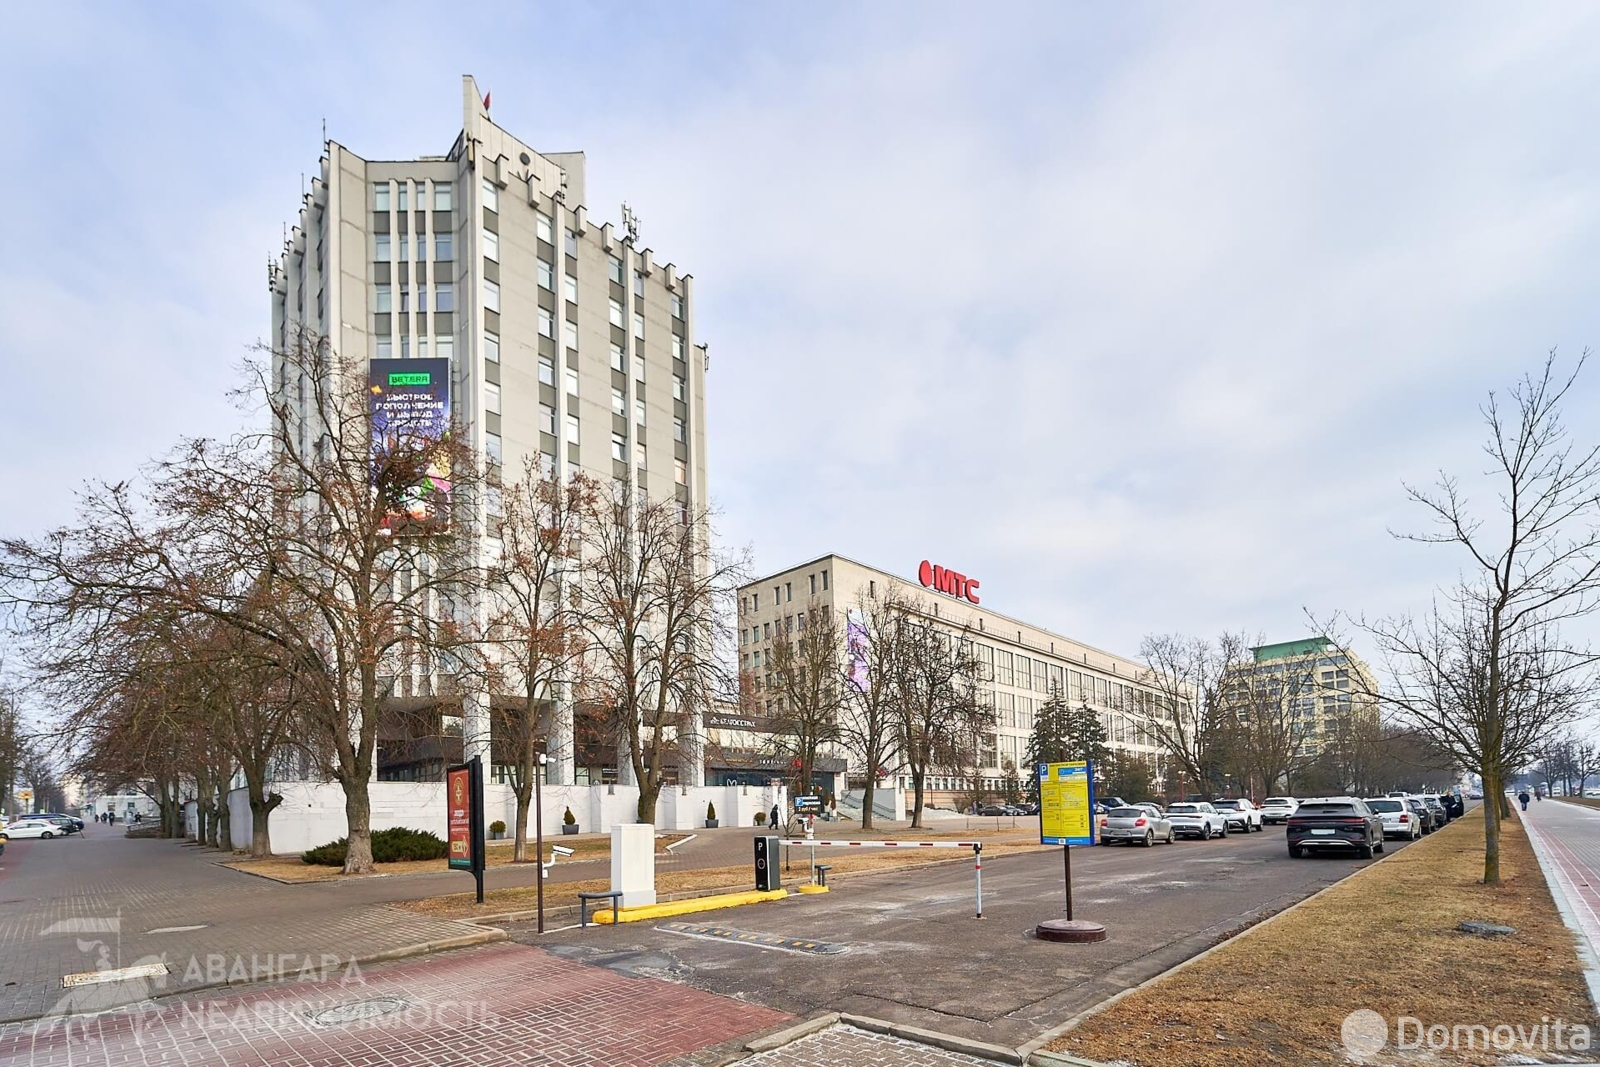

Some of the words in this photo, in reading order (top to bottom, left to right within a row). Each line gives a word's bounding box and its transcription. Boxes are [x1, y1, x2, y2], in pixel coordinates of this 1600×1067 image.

[391, 375, 429, 384] BETERA
[933, 564, 980, 605] МТС
[757, 842, 763, 851] P
